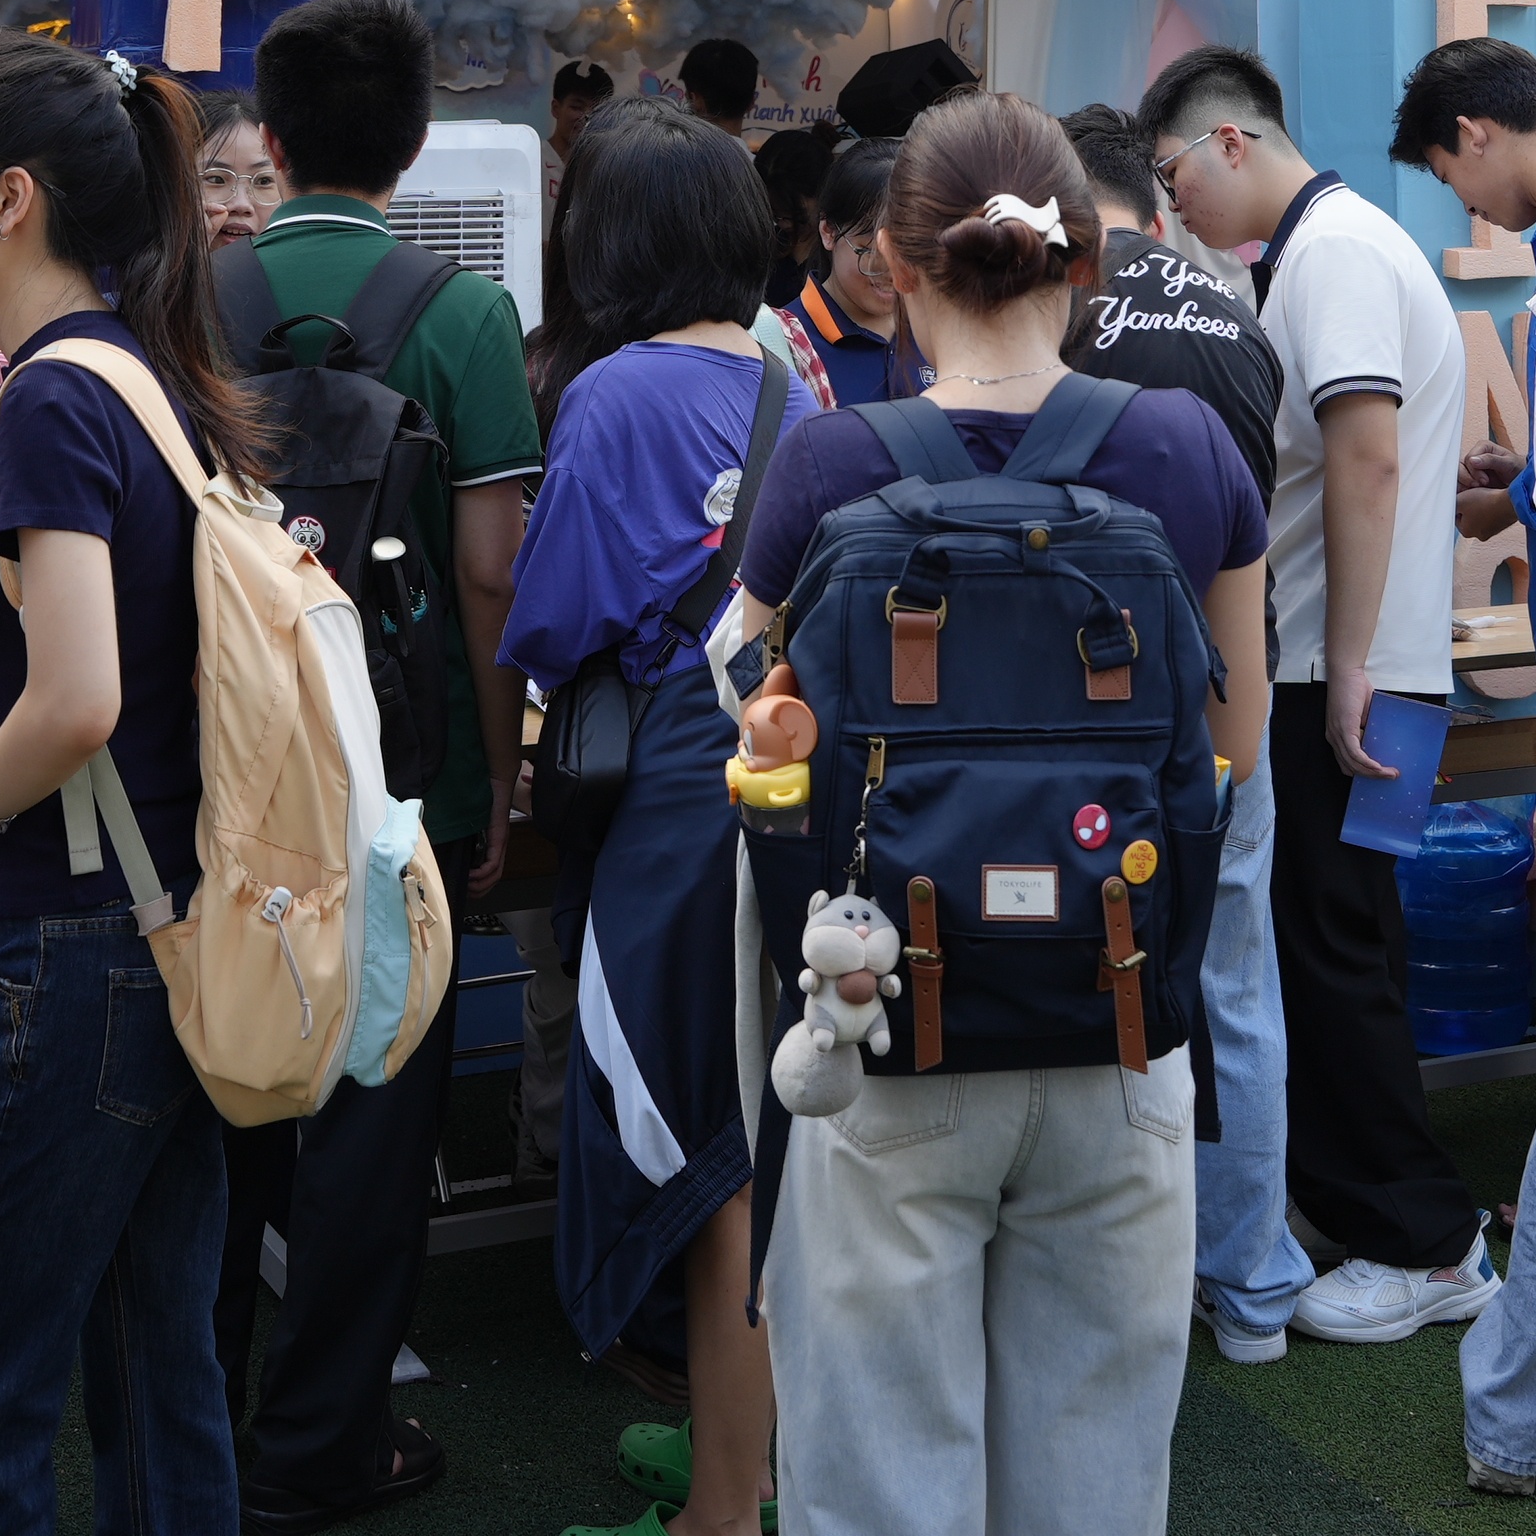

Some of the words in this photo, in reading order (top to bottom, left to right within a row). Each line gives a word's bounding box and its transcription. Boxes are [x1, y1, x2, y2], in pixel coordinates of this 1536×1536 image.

[1147, 253, 1237, 301] York
[1088, 295, 1241, 351] Yankees
[999, 880, 1042, 889] TOKYOLIFE
